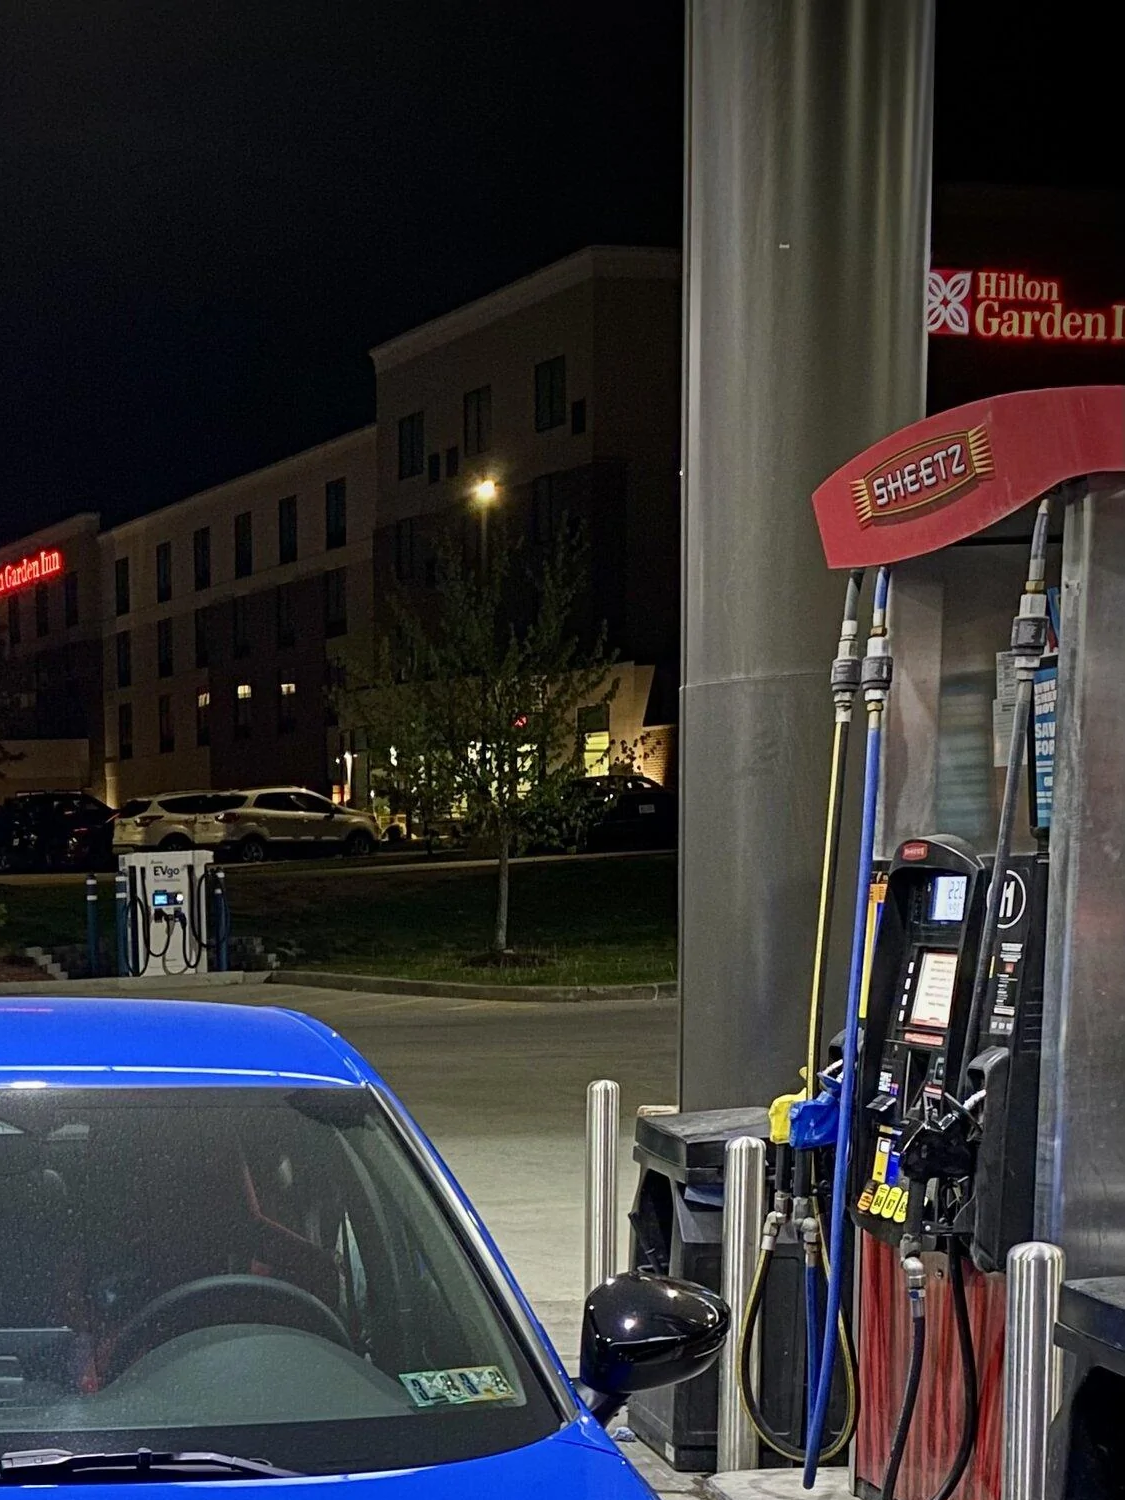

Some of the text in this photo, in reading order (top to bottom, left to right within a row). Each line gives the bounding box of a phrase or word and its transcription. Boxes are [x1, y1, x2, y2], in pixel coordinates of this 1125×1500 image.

[976, 271, 1059, 301] Hilton
[975, 300, 1108, 341] Garden
[872, 443, 967, 507] SHEETZ
[4, 558, 41, 588] Garden
[39, 551, 61, 576] Inn
[154, 866, 180, 878] EVgo
